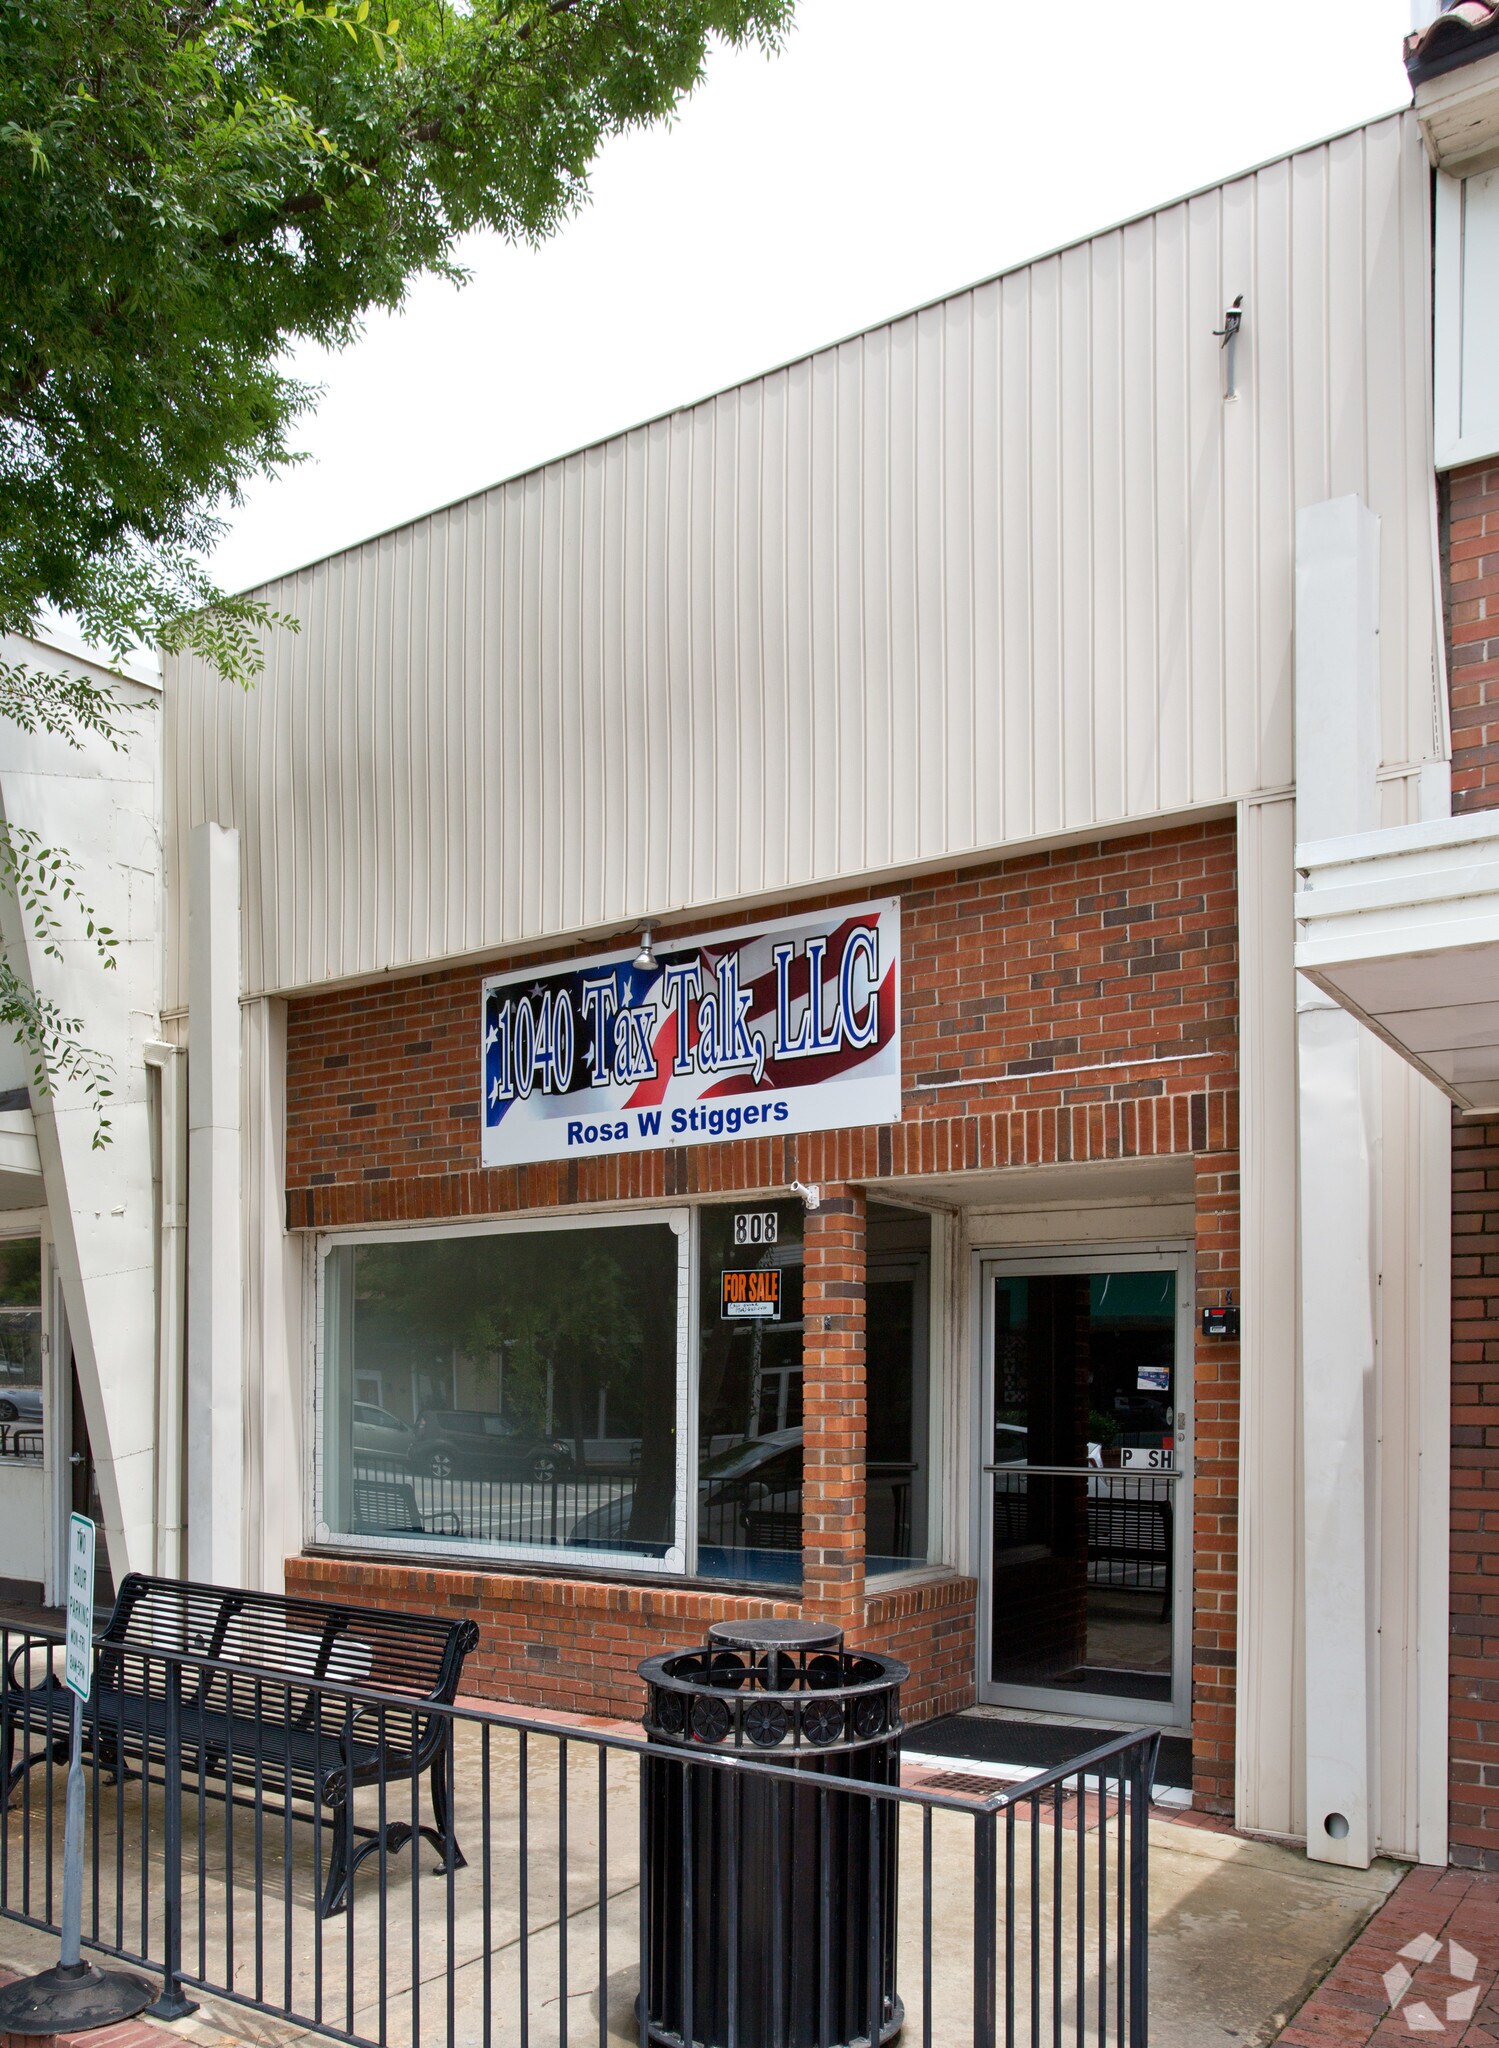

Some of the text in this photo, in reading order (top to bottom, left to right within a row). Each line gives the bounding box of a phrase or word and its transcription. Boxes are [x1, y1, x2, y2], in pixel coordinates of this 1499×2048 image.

[497, 923, 880, 1100] 1040 Tax Talk, LLC
[567, 1101, 789, 1146] Rosa W Stiggers
[736, 1213, 775, 1243] 808
[724, 1272, 778, 1302] FOR SALE
[1122, 1449, 1172, 1469] PSH
[76, 1530, 87, 1554] TWO
[73, 1564, 87, 1591] HOUR
[69, 1595, 89, 1628] PARKING
